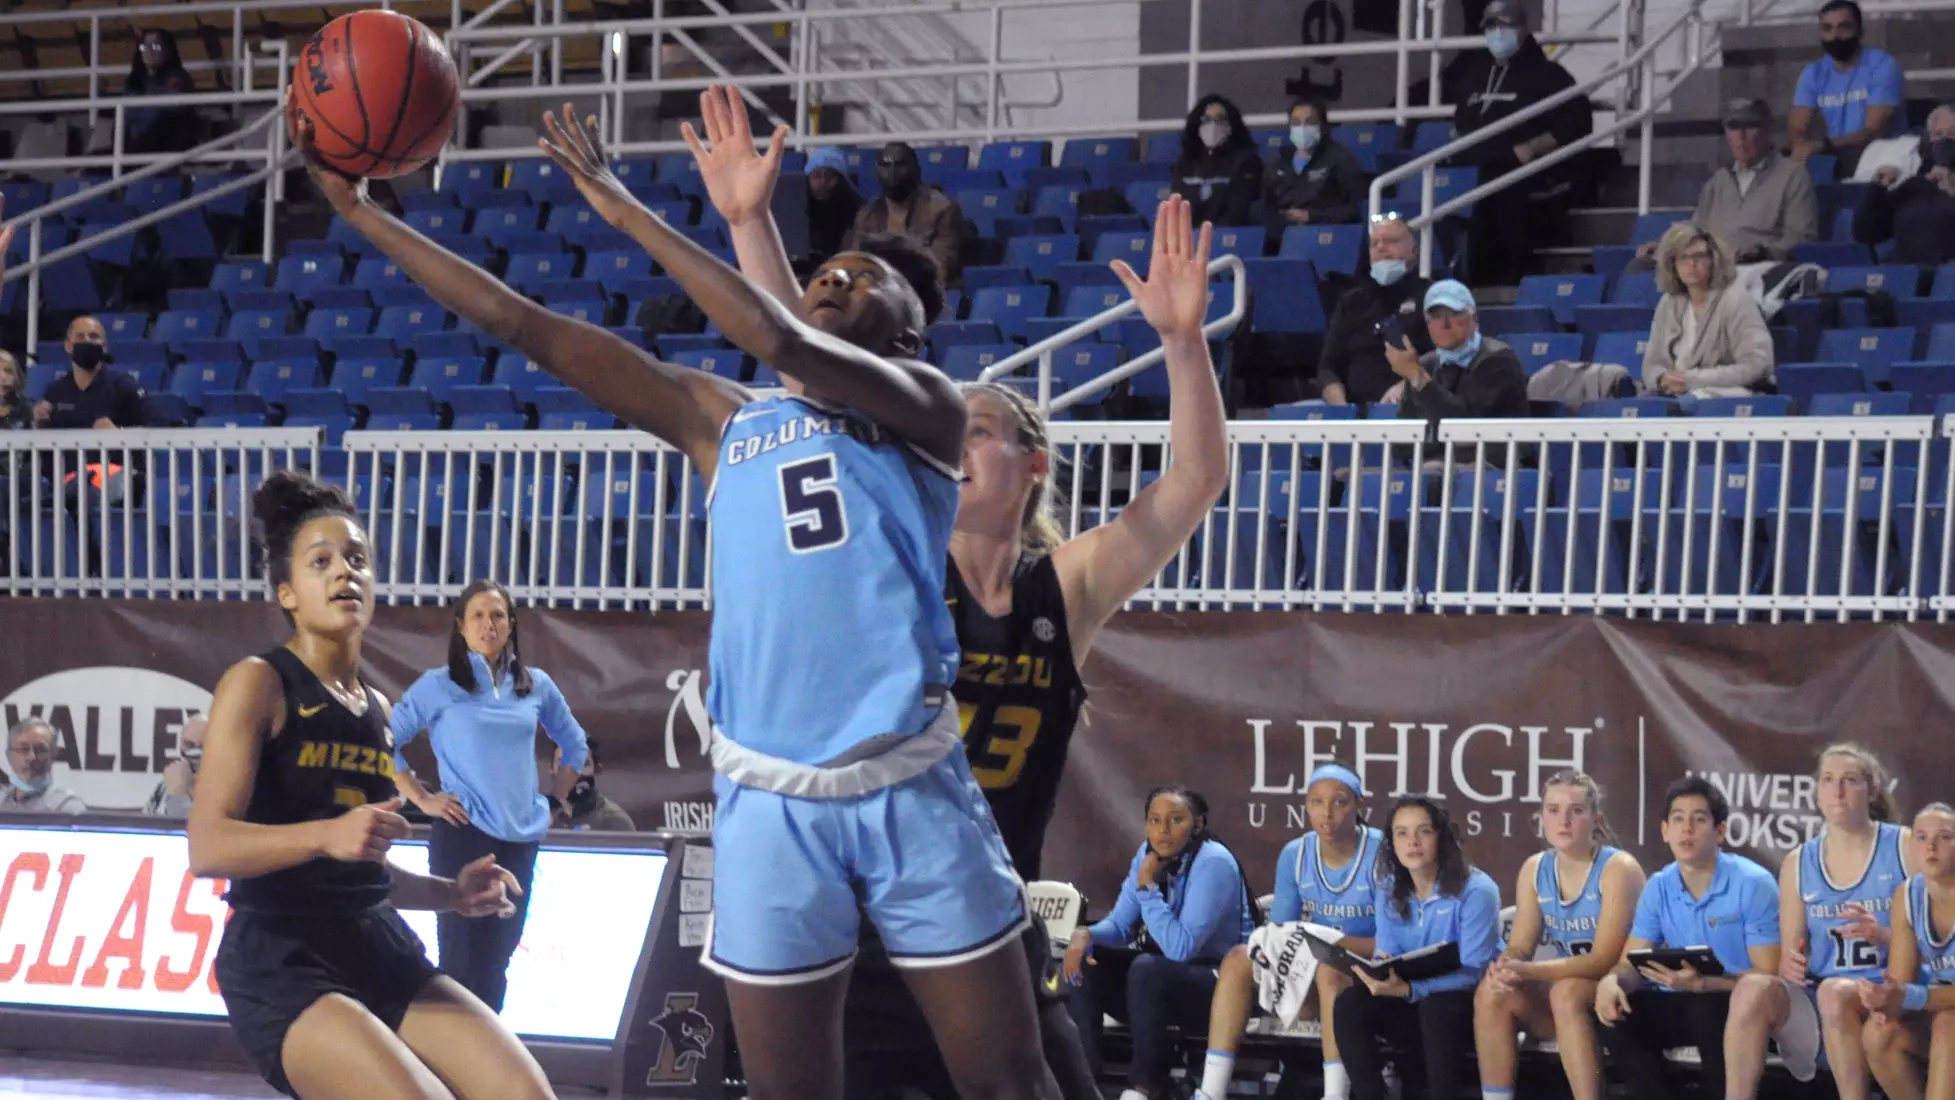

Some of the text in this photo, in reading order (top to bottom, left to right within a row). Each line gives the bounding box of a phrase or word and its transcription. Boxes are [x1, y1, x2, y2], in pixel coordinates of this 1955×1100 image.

[728, 416, 880, 466] COLUM
[777, 452, 849, 555] 5
[957, 653, 1052, 688] ZZOU
[5, 703, 201, 773] ALLE
[297, 742, 397, 782] MIZZO
[1246, 719, 1593, 803] LEHIGH
[664, 801, 713, 831] IRISH
[0, 852, 235, 995] CLAS
[1032, 896, 1070, 920] IGH
